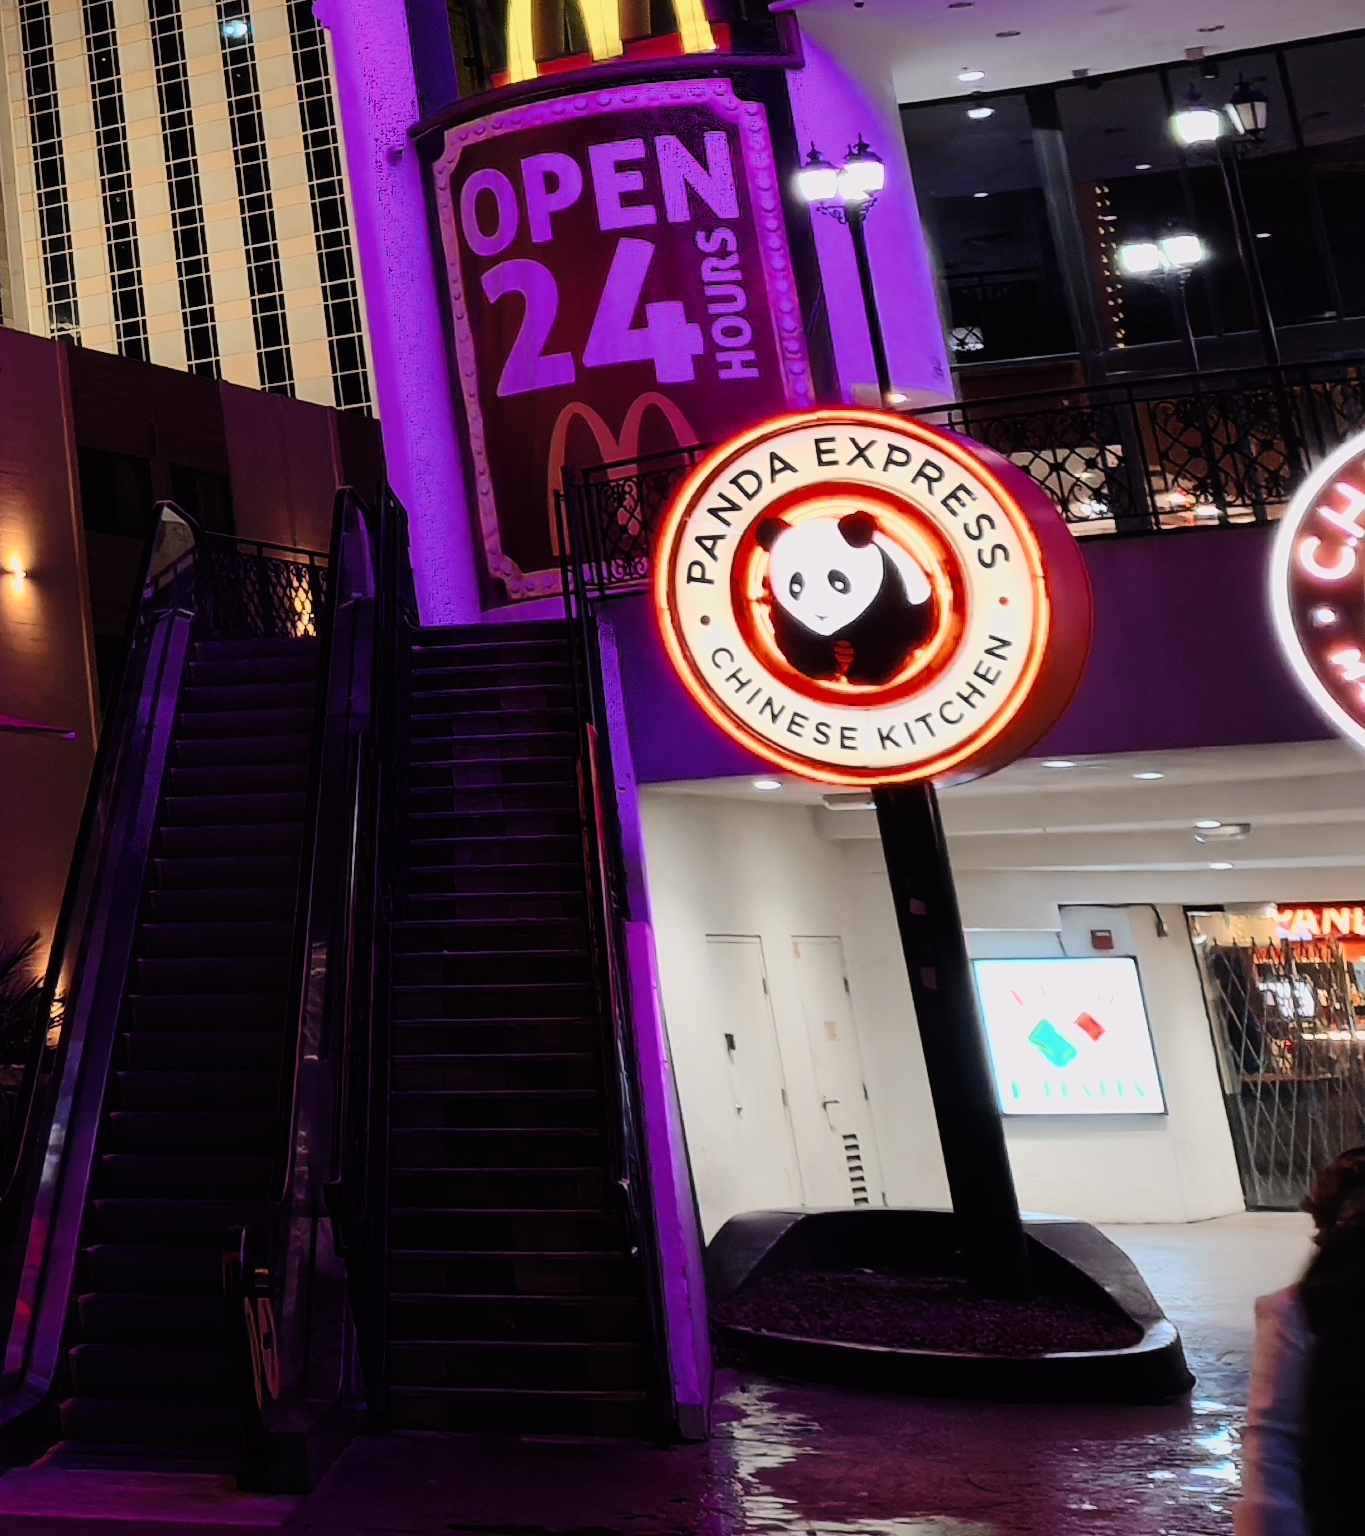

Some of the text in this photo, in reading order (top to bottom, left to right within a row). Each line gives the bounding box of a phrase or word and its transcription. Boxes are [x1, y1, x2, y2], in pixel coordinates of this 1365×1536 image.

[460, 131, 740, 257] OPEN
[481, 237, 705, 397] 24
[696, 226, 760, 381] HOURS
[686, 437, 1011, 586] PANDA EXPRESS
[711, 633, 1014, 751] CHINESE KITCHEN
